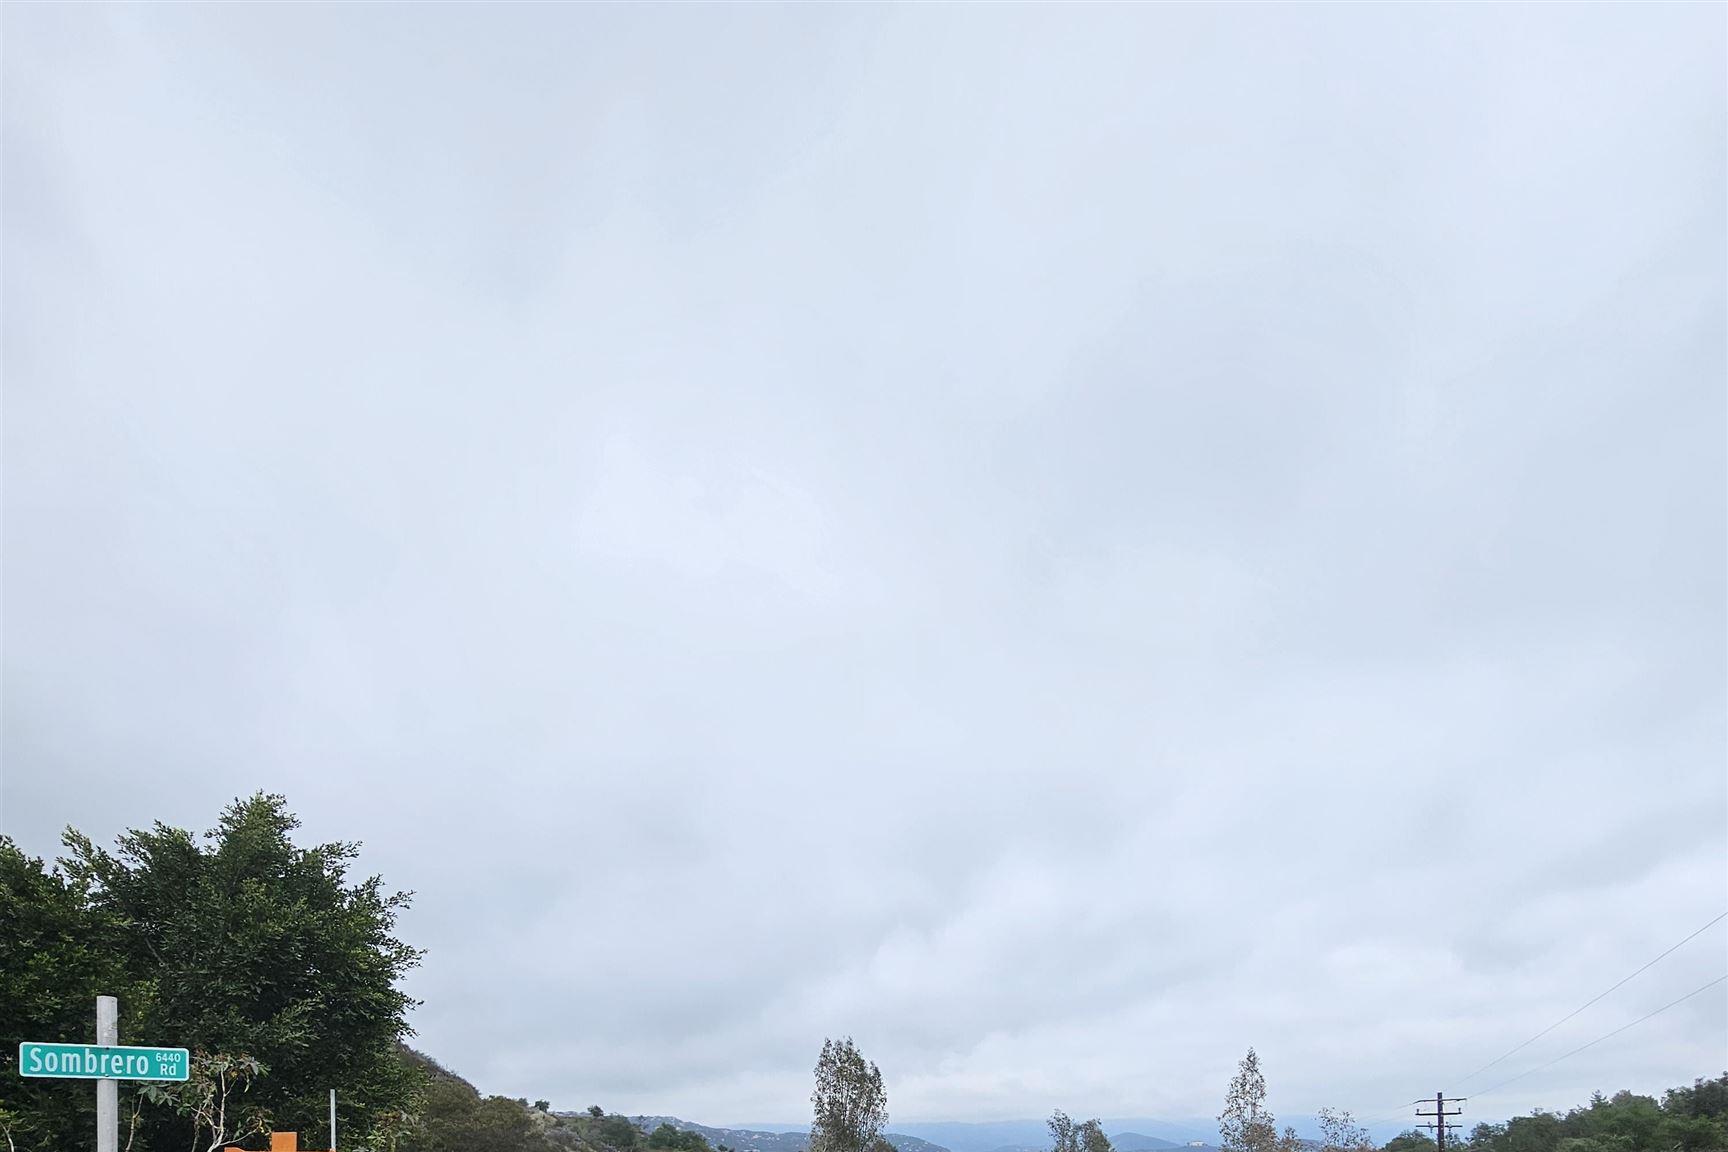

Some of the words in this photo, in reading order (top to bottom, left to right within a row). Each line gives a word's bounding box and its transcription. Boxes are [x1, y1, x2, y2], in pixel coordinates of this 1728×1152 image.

[30, 1047, 149, 1075] Sombrero
[160, 1063, 176, 1076] Rd
[155, 1052, 181, 1063] 6440
